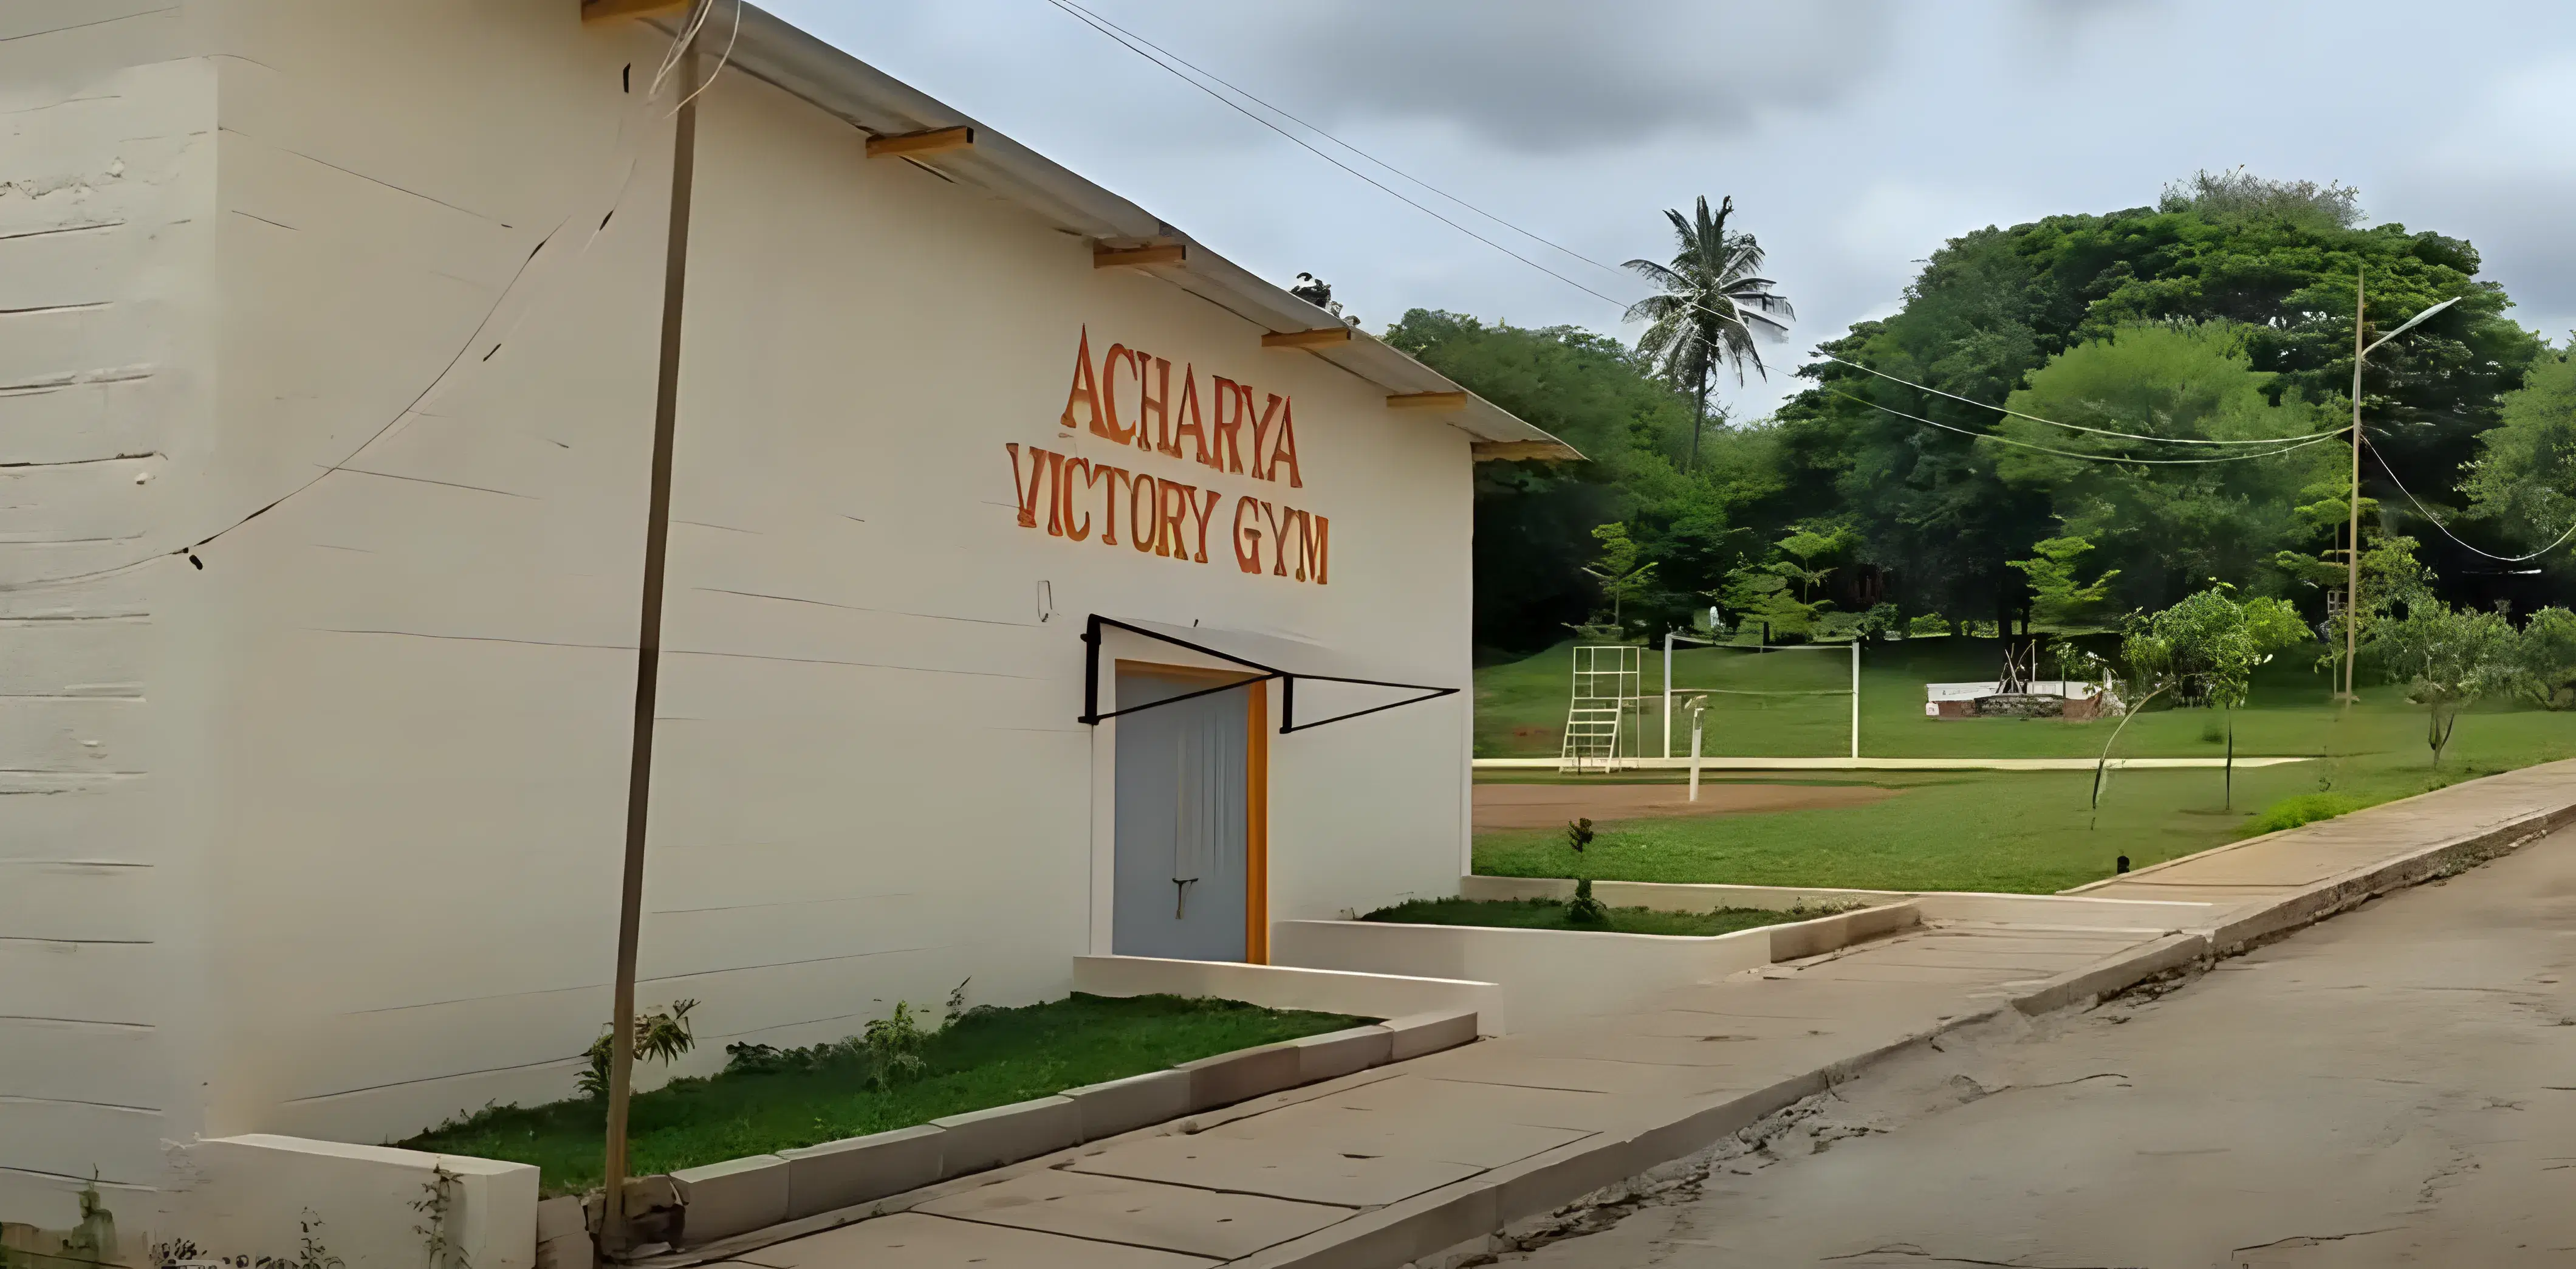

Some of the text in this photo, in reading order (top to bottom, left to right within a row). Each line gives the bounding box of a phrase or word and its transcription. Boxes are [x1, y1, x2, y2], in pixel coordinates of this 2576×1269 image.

[1061, 323, 1303, 487] ACHARYA
[1006, 443, 1329, 585] VICTORY GYM
